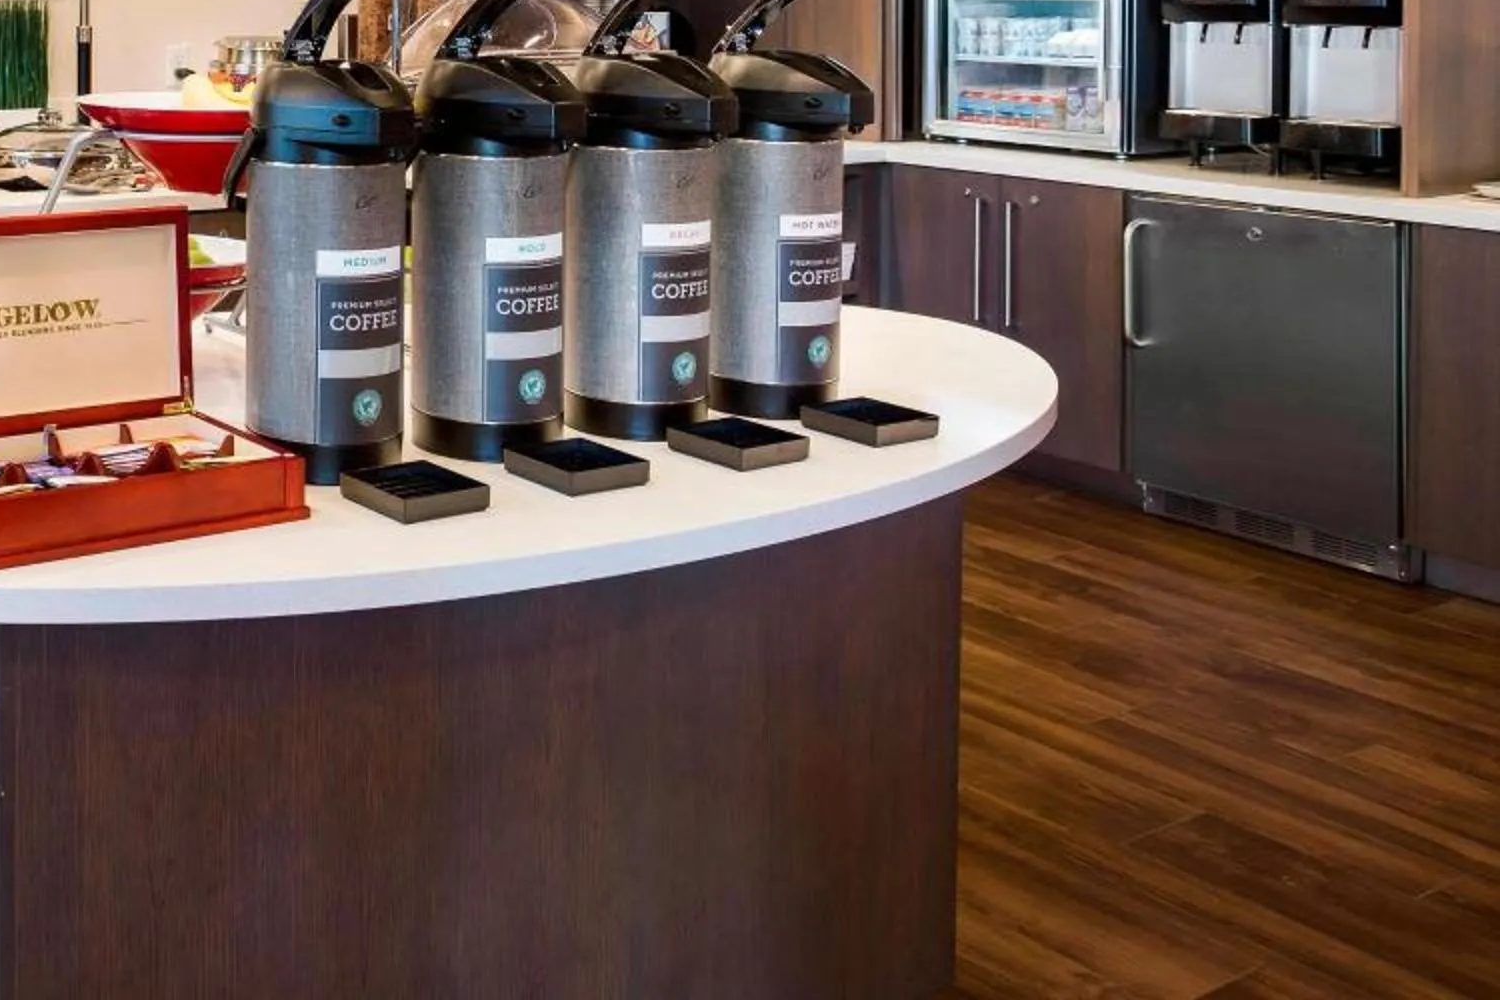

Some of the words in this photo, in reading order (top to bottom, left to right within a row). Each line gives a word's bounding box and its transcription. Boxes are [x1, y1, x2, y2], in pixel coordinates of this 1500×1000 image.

[343, 255, 388, 267] MEDIUM
[789, 267, 840, 285] COFFEE
[651, 280, 708, 299] COFFEE
[495, 293, 559, 315] COFFEE
[329, 310, 397, 331] COFFEE
